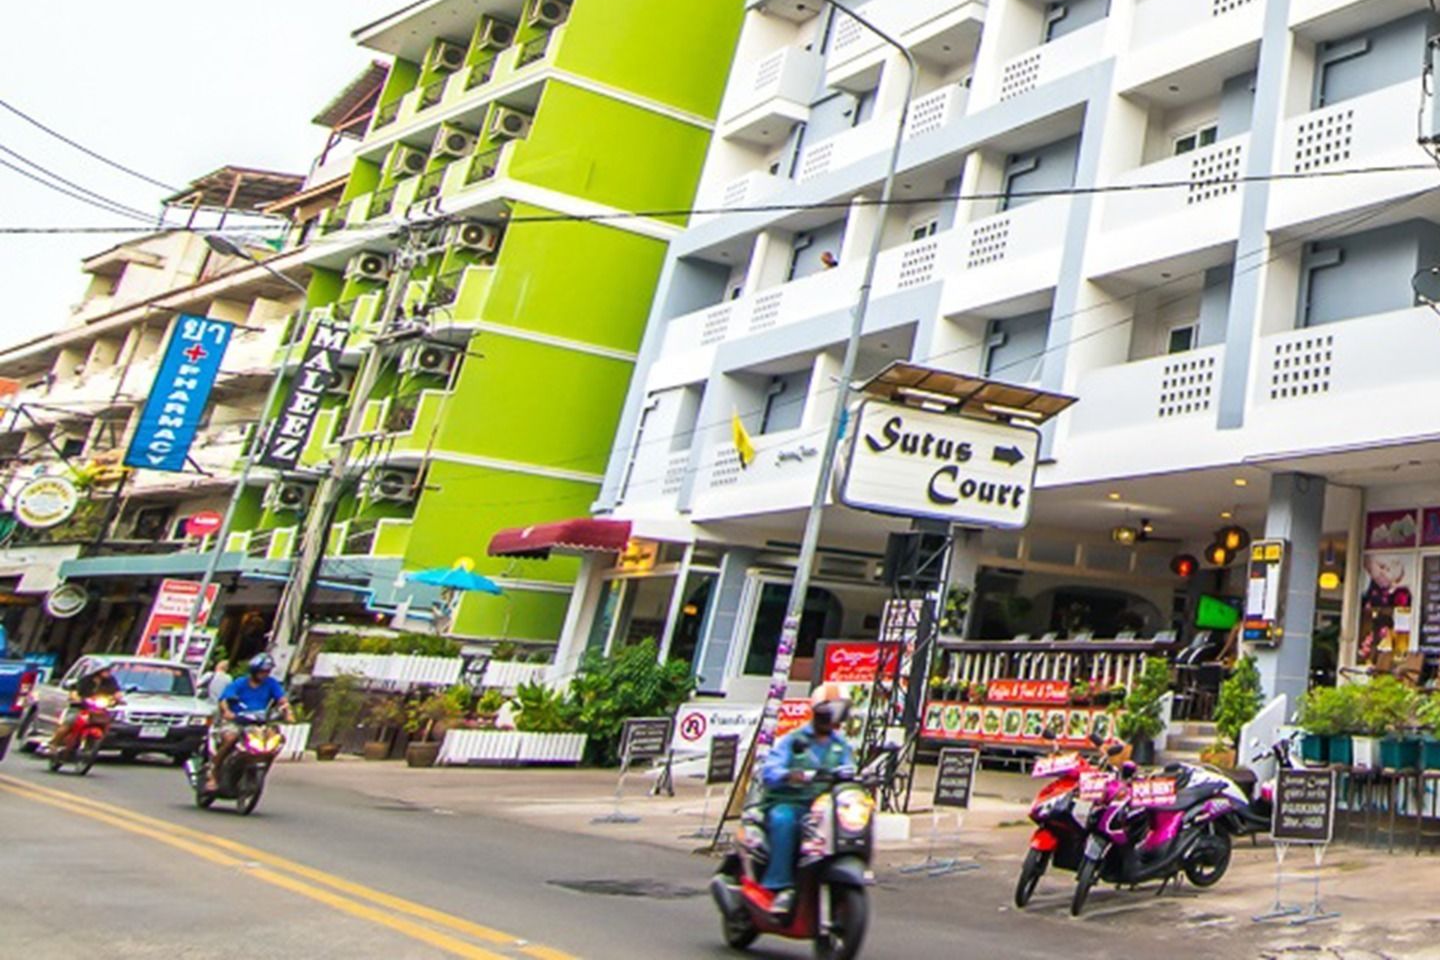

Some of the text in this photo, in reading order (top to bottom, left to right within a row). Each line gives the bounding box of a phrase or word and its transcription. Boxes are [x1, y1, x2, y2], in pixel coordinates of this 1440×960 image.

[182, 319, 226, 344] ยา
[147, 365, 199, 464] PHARMACY
[865, 417, 972, 462] Sutus
[927, 465, 1024, 508] Court
